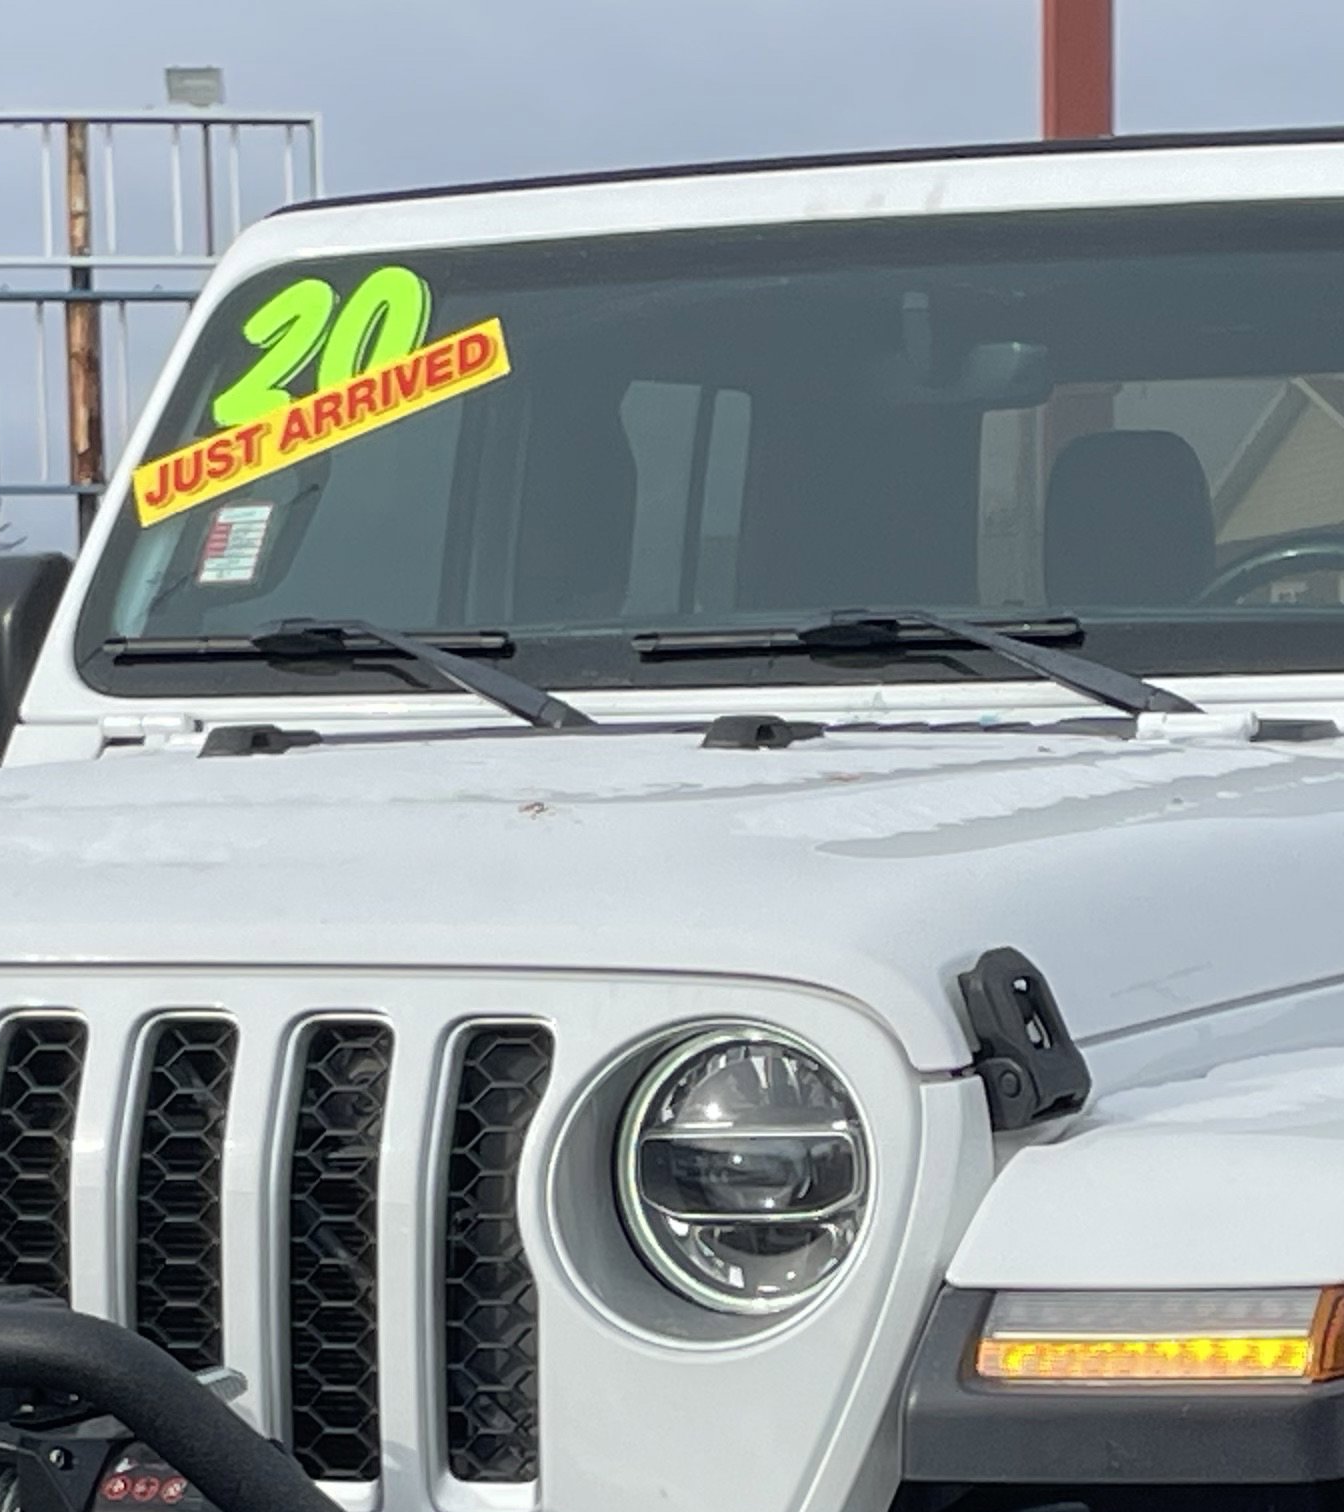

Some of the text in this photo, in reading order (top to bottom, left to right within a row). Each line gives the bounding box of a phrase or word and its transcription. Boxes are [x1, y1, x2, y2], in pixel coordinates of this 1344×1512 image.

[144, 333, 499, 508] JUST ARRIVED
[213, 267, 433, 425] 20
